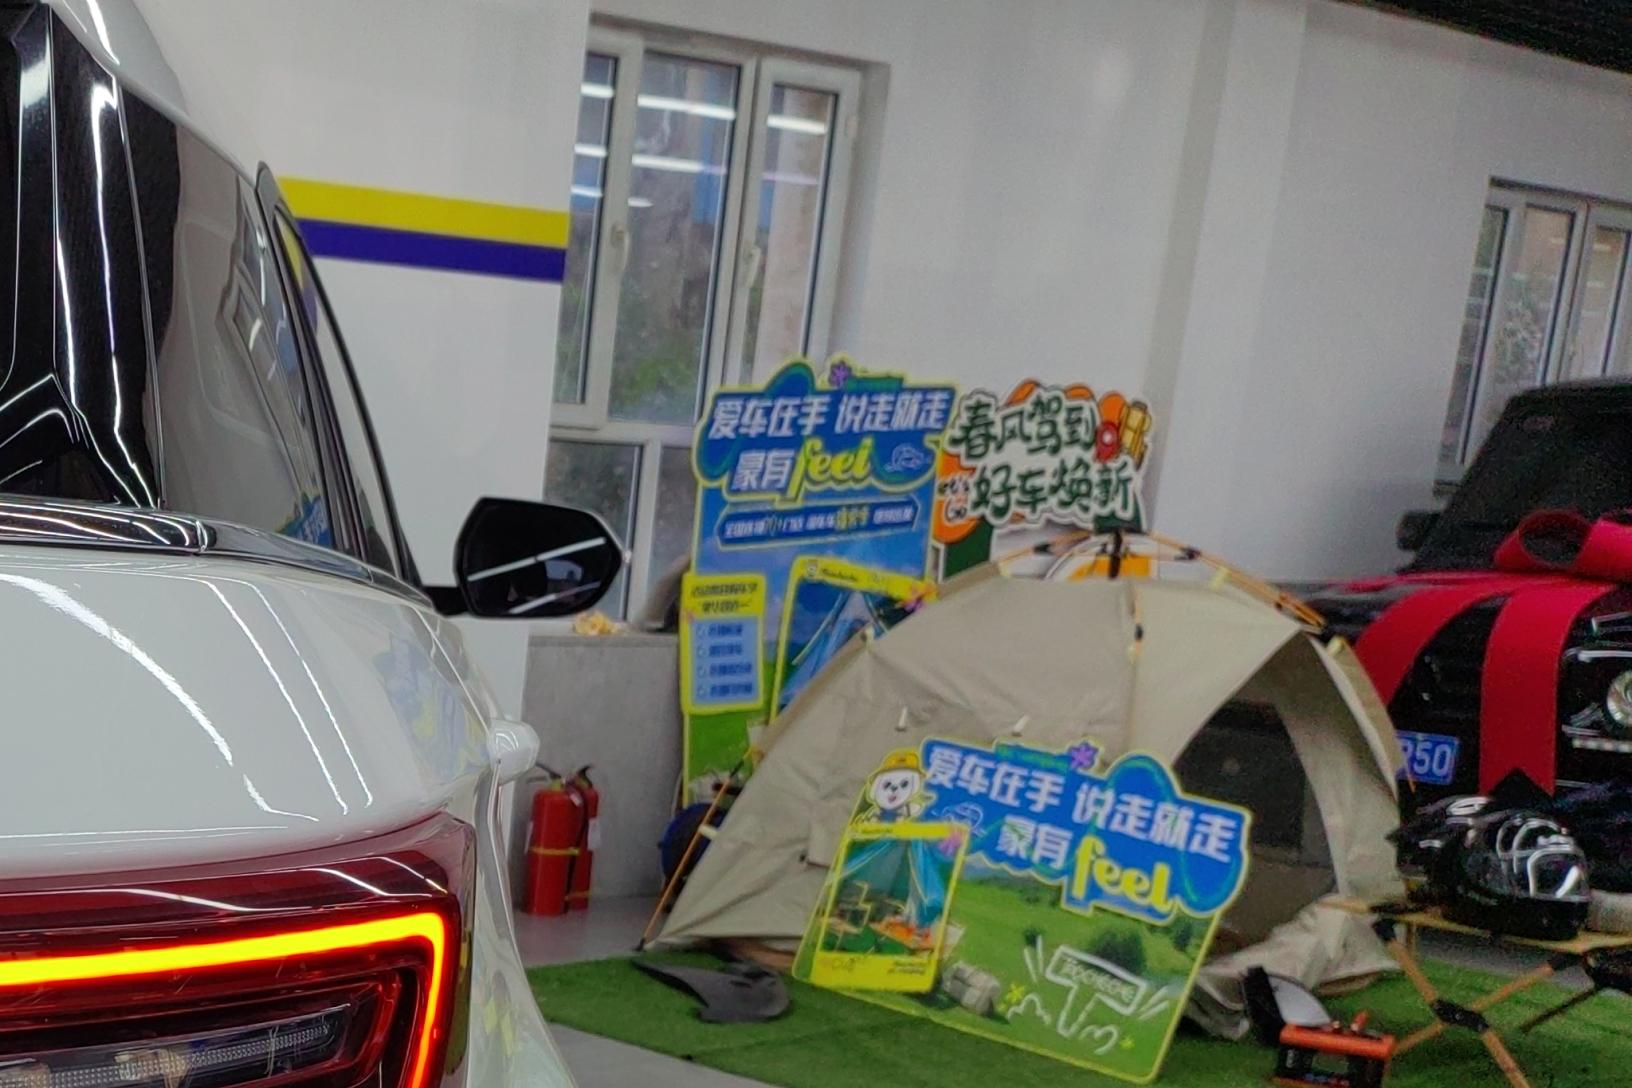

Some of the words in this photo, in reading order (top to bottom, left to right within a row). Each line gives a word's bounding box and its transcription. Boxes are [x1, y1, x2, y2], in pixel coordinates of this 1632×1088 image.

[708, 395, 830, 440] 爱车在手
[835, 391, 949, 434] 说走就走
[950, 395, 1096, 458] 春风驾到
[786, 436, 875, 501] feel
[970, 456, 1132, 519] 好车焕新
[926, 746, 1066, 813] 爱车在手
[1071, 781, 1238, 864] 说走就走
[1071, 834, 1172, 912] feel
